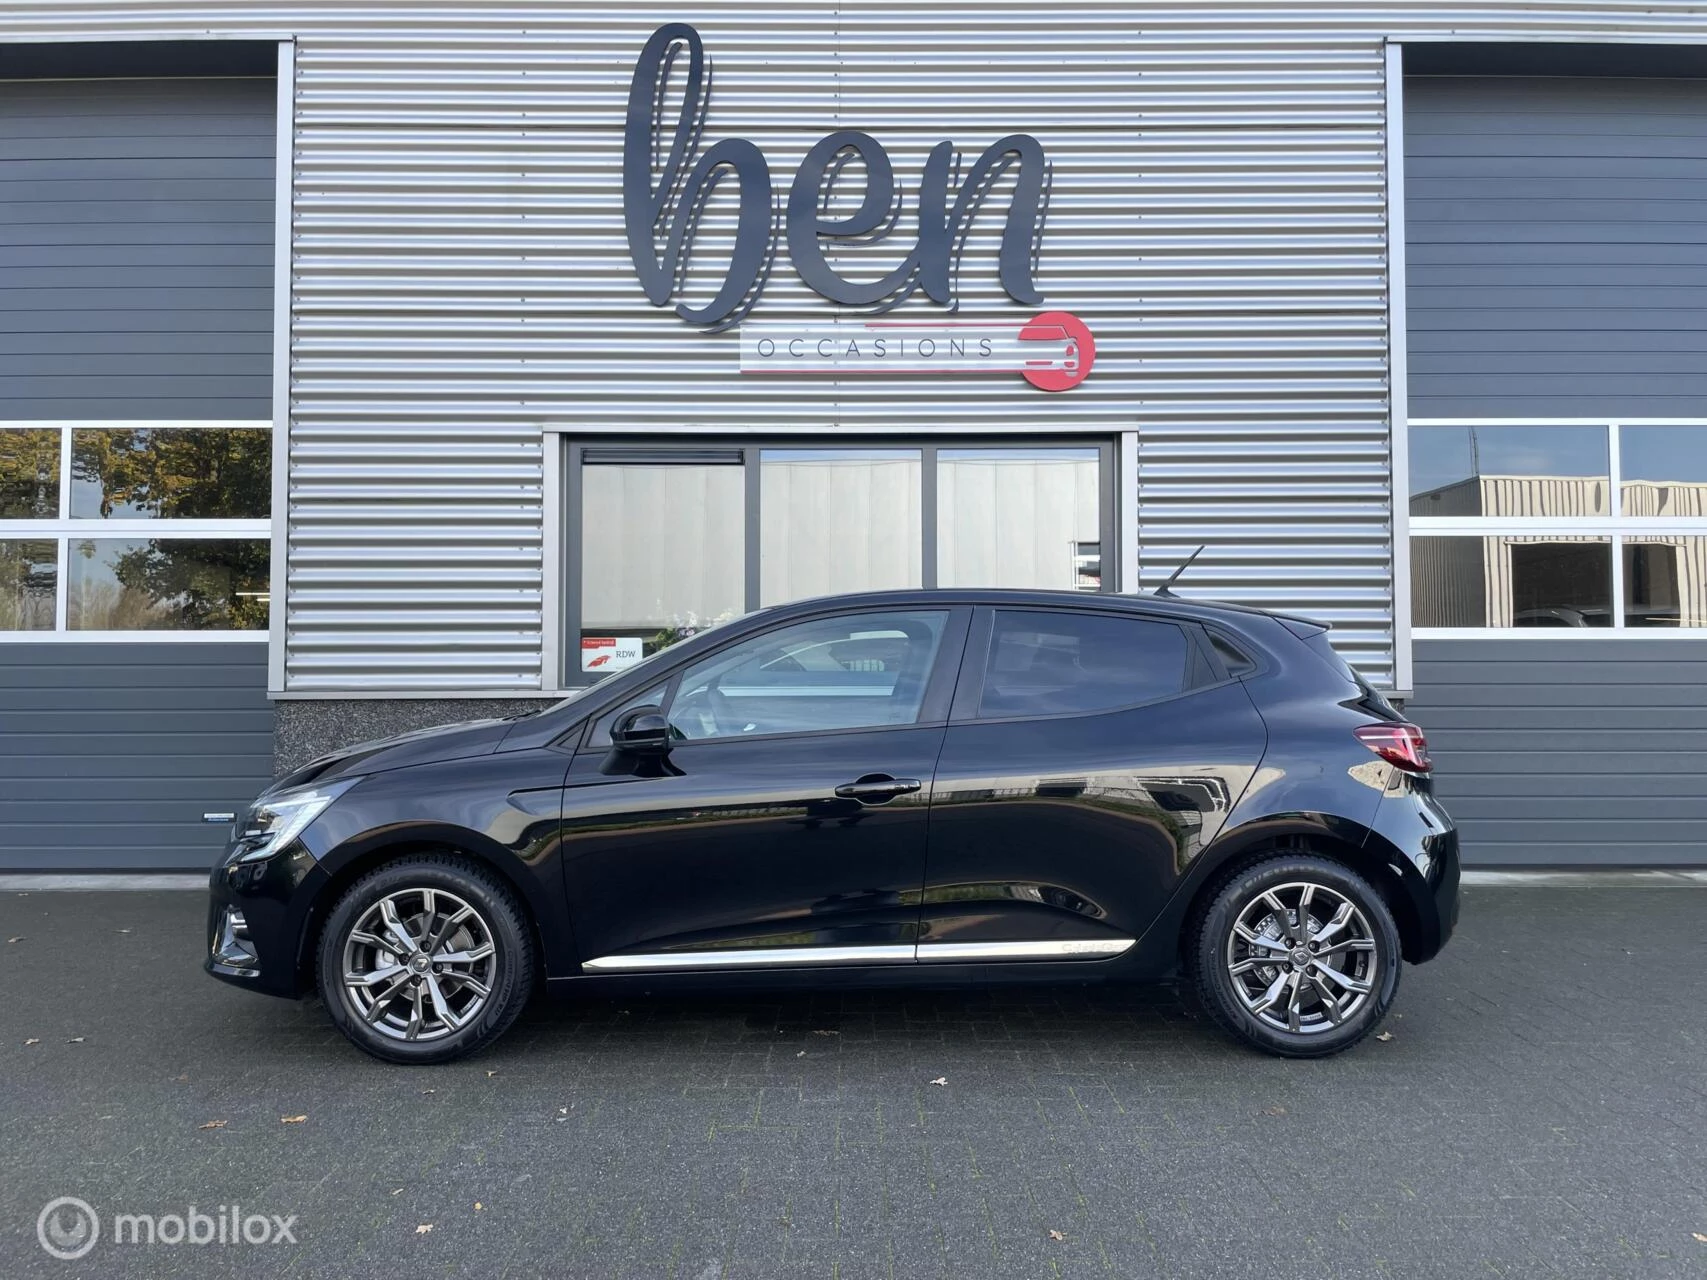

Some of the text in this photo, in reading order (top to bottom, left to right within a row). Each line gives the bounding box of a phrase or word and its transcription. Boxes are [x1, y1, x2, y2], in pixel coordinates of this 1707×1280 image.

[623, 22, 1051, 330] ben
[757, 337, 993, 358] OCCASIONS
[615, 650, 636, 658] RDW
